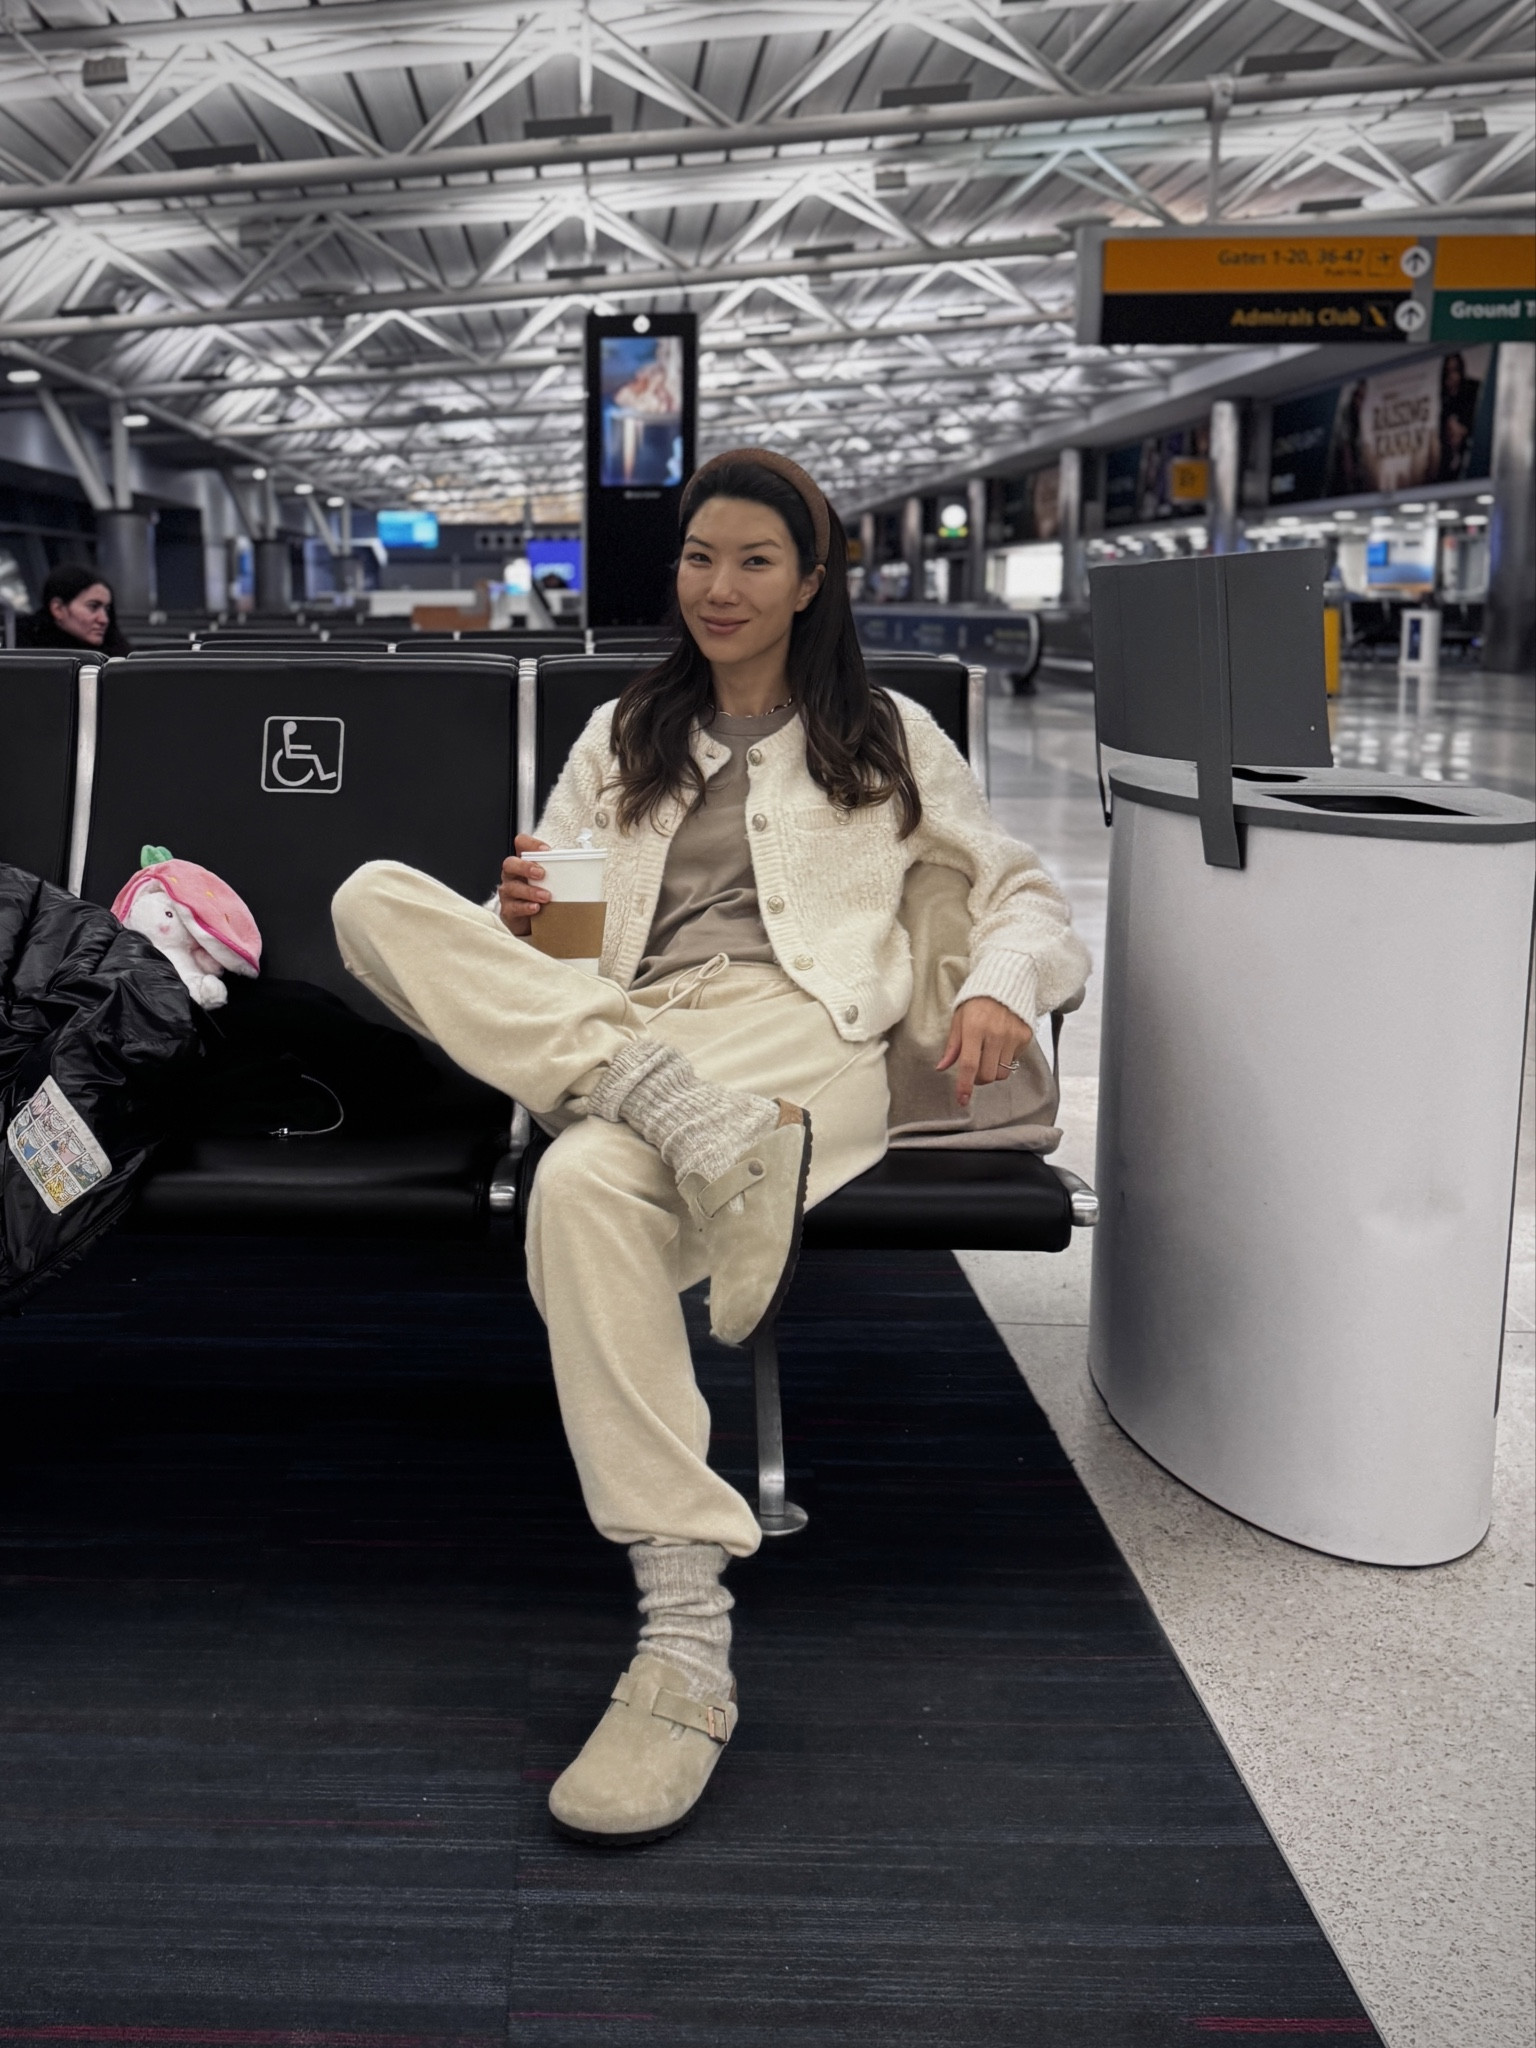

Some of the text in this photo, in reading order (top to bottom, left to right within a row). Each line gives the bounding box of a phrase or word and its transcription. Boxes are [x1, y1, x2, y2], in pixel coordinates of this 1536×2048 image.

[1218, 249, 1266, 266] Gates
[1231, 307, 1361, 327] Admirals Club
[1450, 300, 1521, 319] Ground
